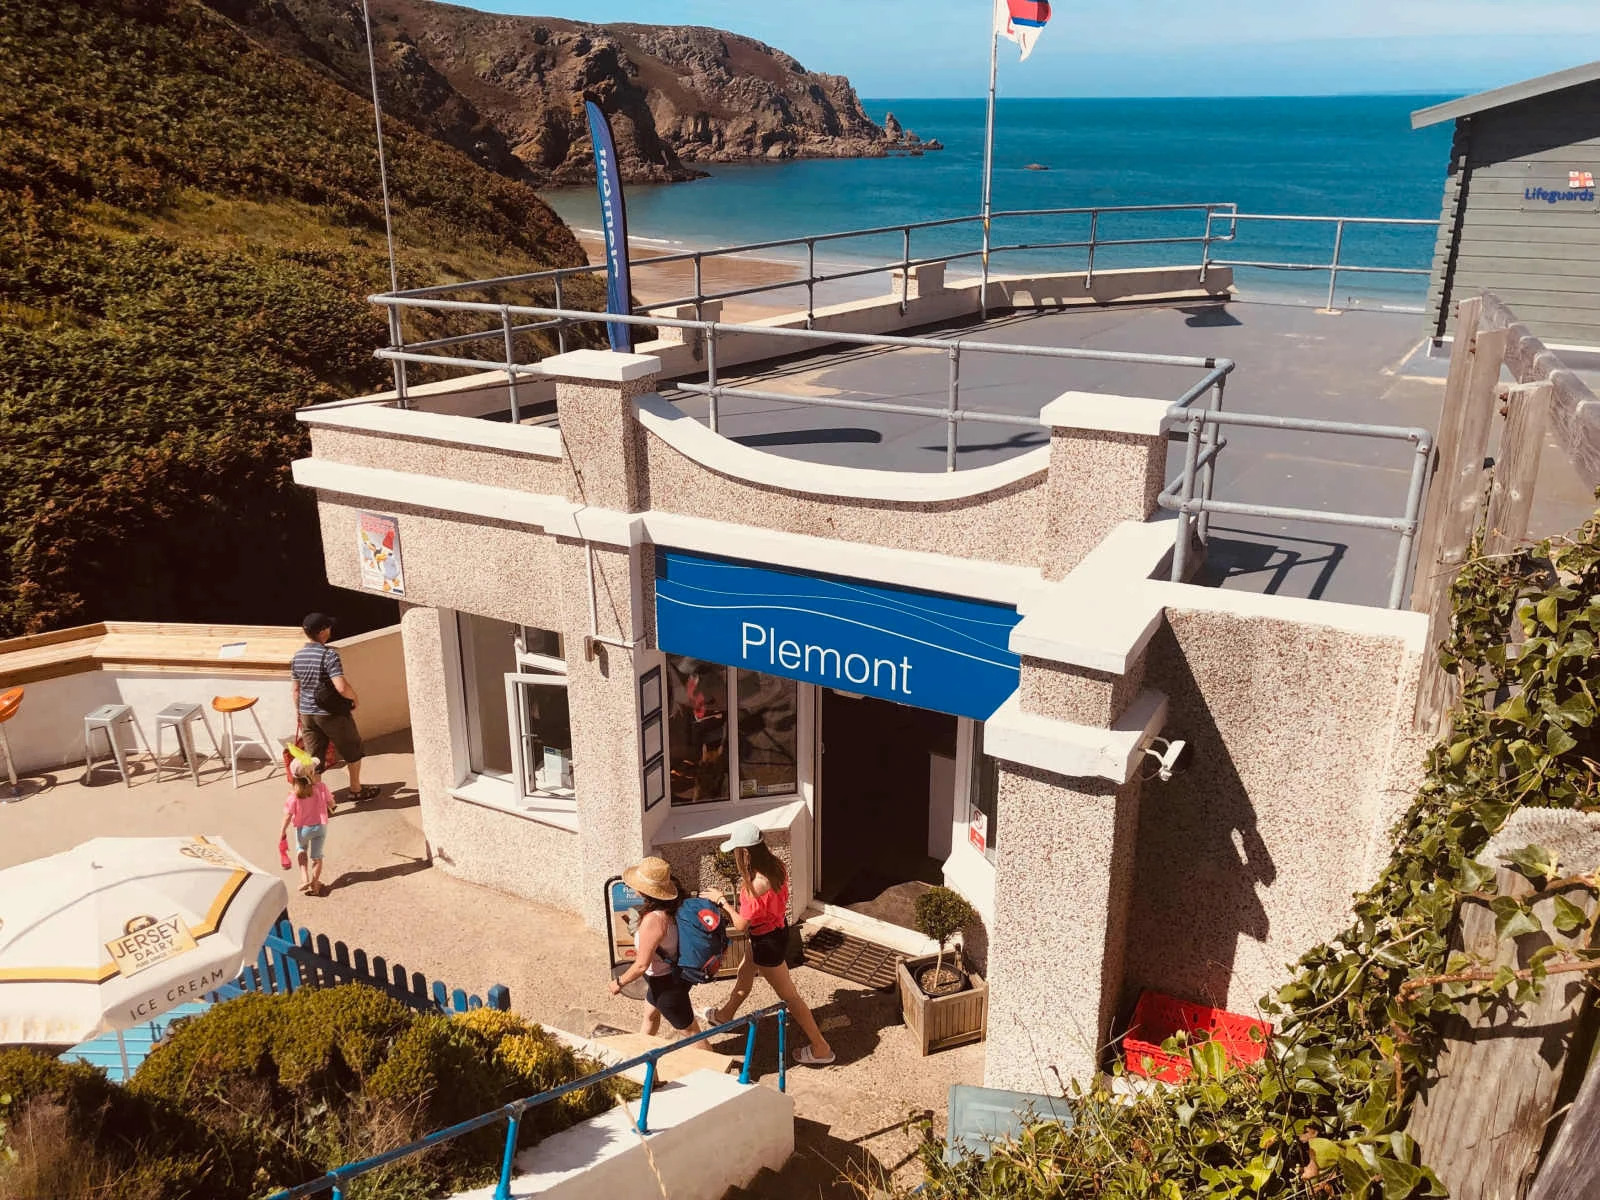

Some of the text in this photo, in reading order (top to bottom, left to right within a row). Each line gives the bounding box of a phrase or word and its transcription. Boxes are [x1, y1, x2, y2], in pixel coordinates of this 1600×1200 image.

[1524, 186, 1595, 204] Lifeguards
[741, 621, 913, 695] Plemont
[116, 919, 180, 959] JERSEY
[134, 938, 174, 962] DAIRY
[130, 968, 224, 1021] ICE CREAM
